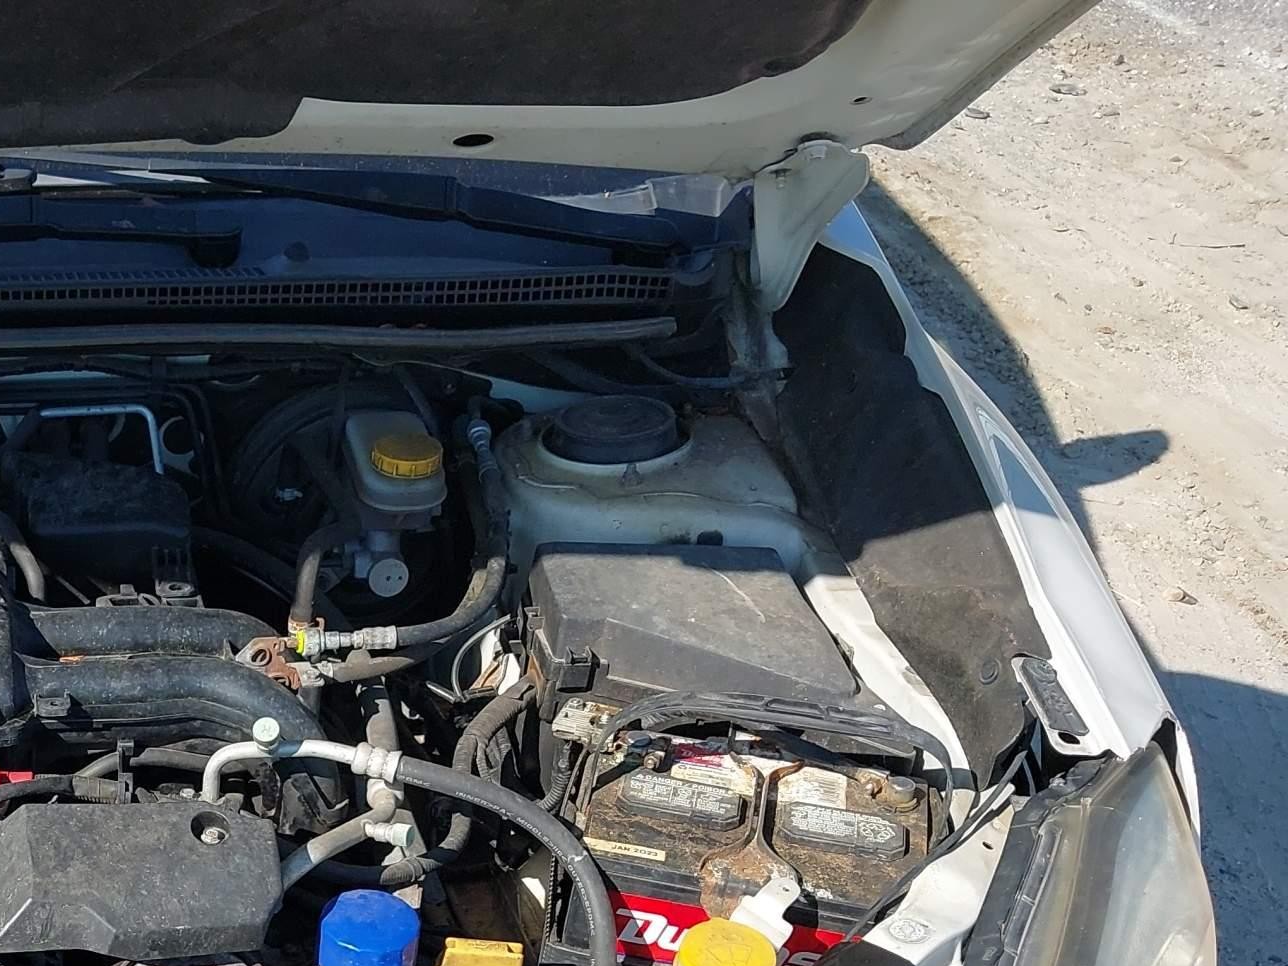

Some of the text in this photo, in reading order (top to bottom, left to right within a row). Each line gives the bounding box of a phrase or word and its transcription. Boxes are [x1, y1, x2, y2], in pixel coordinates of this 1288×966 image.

[645, 775, 682, 788] DANGER
[612, 844, 658, 857] JAN 2023
[566, 864, 596, 936] OUTER>EPDM<
